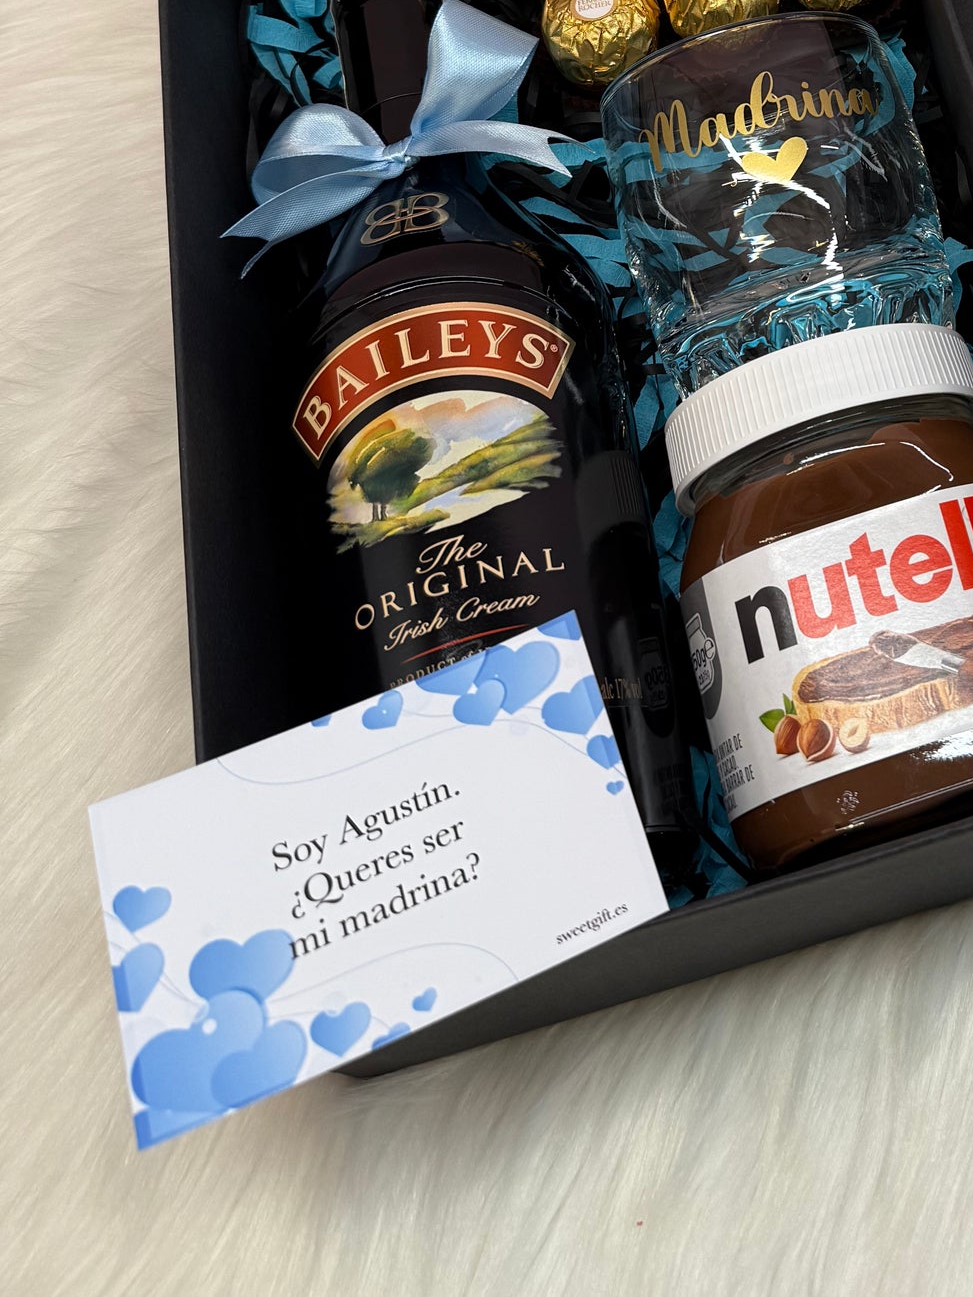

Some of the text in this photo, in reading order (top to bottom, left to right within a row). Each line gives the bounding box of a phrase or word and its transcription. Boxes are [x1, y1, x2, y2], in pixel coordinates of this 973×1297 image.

[578, 0, 612, 12] ROCHER
[638, 70, 879, 173] Madrina
[354, 548, 566, 631] ORIGINAL
[415, 534, 488, 575] The
[383, 592, 541, 652] Irish Cream
[271, 781, 462, 873] Soy Agustín.
[288, 852, 482, 961] mi madrina?
[291, 820, 466, 920] ¿Queres ser
[555, 900, 629, 946] sweetgift.es
